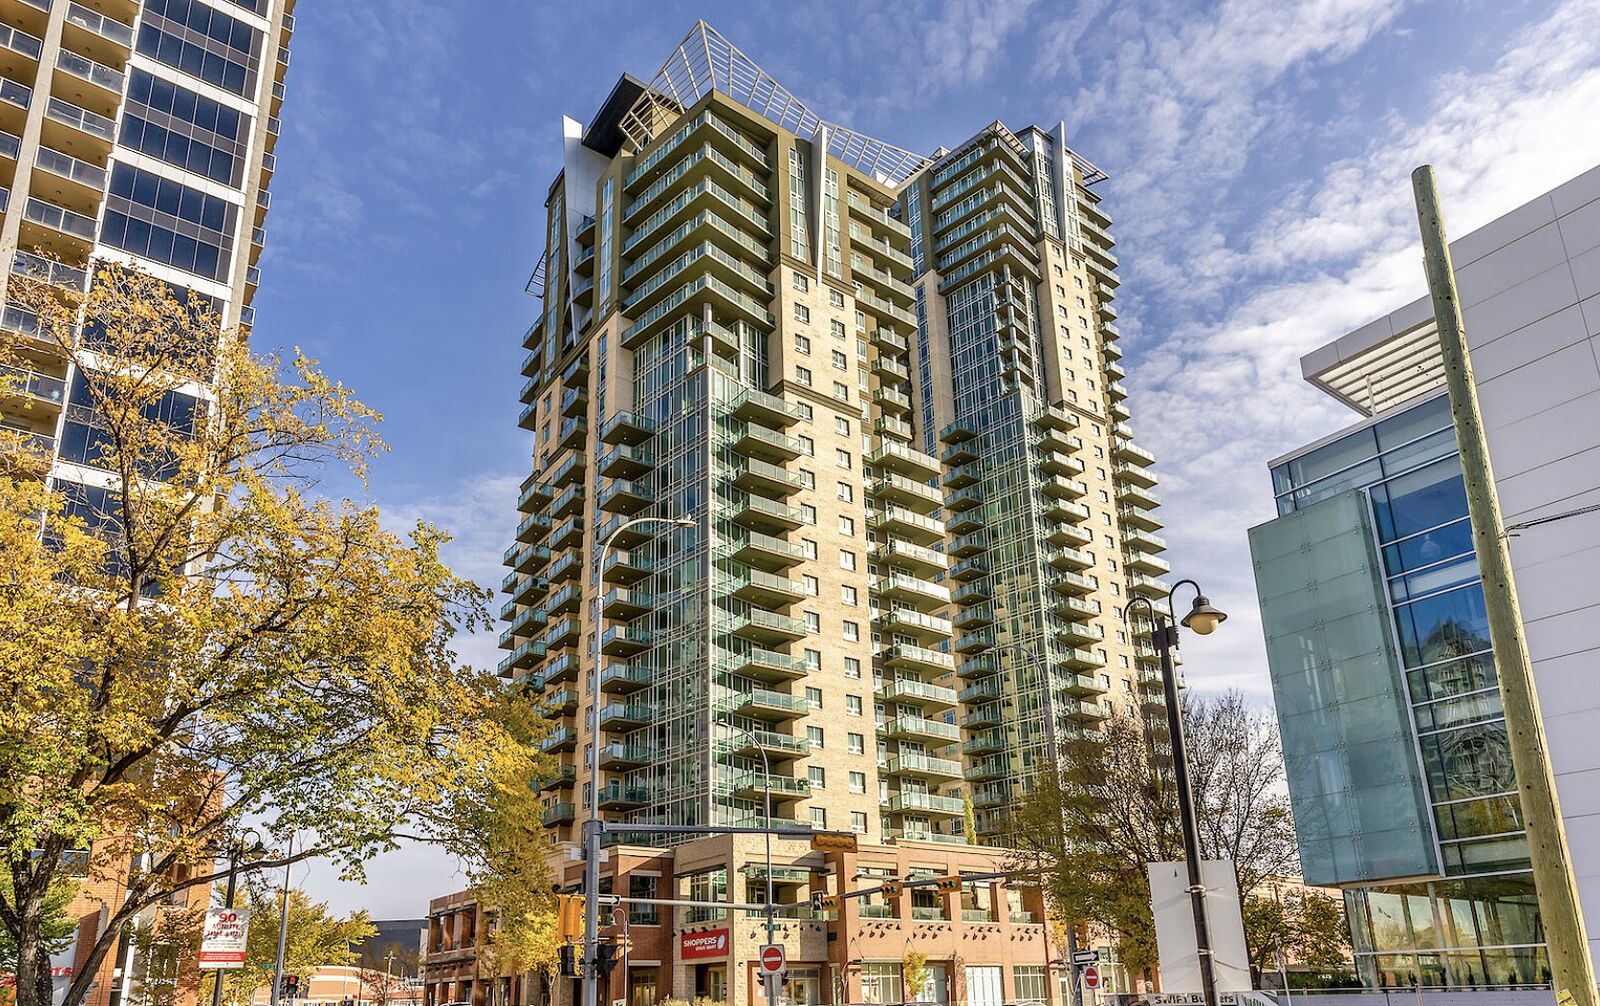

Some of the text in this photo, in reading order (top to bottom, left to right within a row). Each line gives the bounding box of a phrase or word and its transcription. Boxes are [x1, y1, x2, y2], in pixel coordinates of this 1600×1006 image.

[219, 913, 238, 922] 90
[683, 937, 717, 947] SHOPPERS
[1155, 994, 1188, 1004] SWIFT
